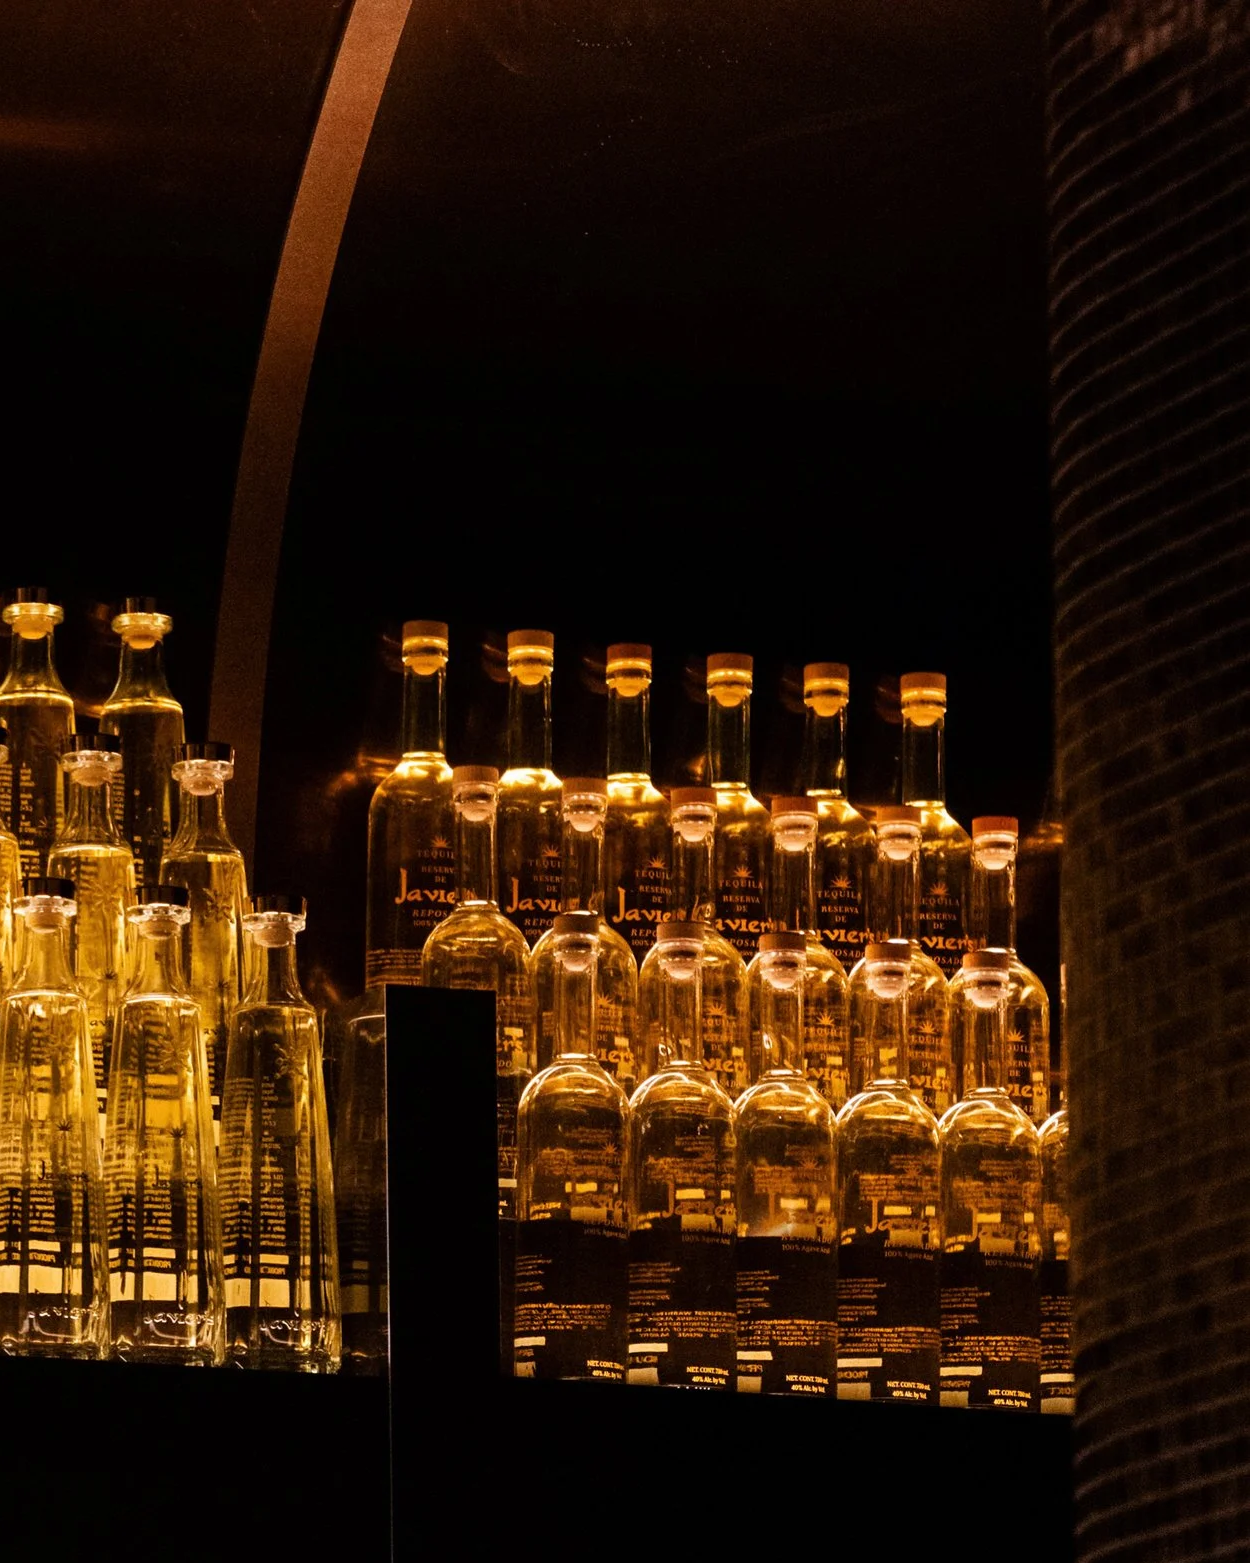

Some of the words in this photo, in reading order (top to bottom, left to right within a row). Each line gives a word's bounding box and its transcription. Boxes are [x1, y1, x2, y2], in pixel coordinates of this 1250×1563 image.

[435, 876, 447, 884] DE
[718, 879, 764, 889] TEQUILA
[546, 885, 558, 893] DE
[817, 890, 862, 900] TEQUILA
[723, 895, 761, 904] RESERVA
[736, 905, 748, 913] DE
[821, 905, 859, 914] RESERVA
[835, 915, 847, 923] DE
[919, 913, 957, 921] RESERVA
[933, 922, 945, 930] DE
